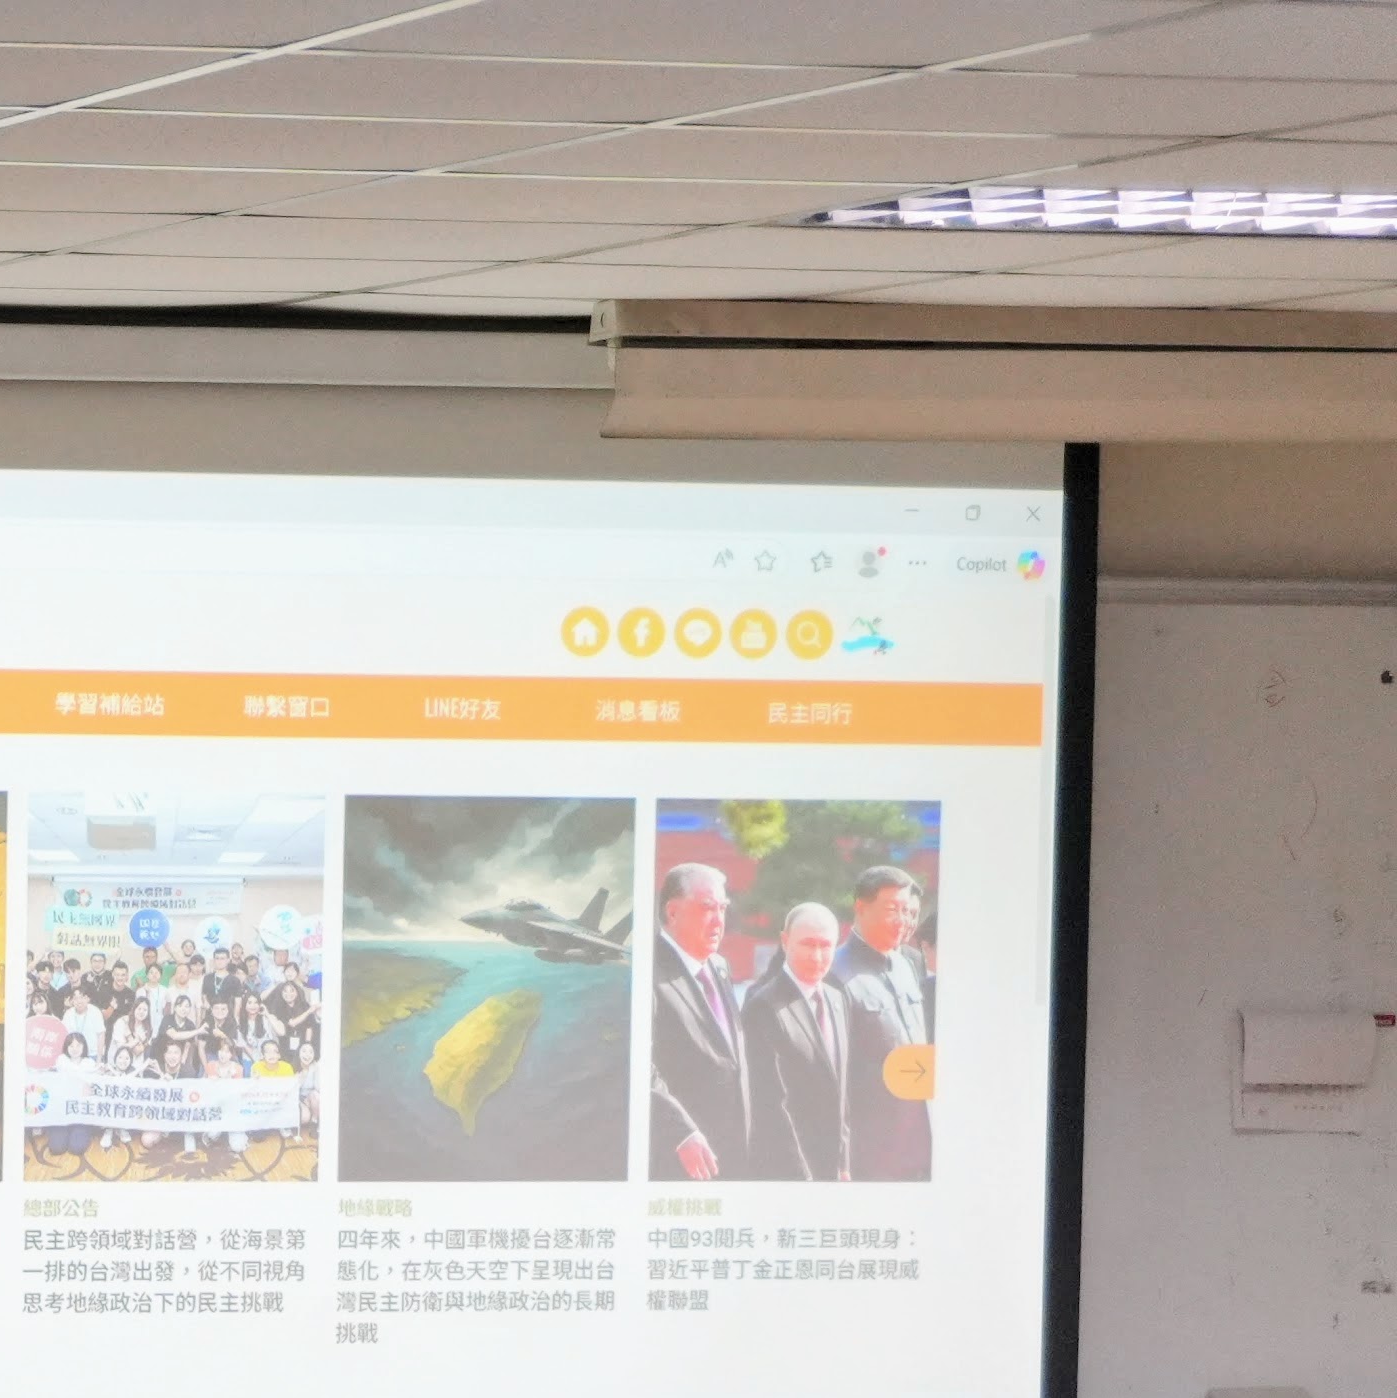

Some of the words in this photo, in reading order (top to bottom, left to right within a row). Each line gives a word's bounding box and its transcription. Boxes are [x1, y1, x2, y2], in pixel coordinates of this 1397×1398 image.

[956, 556, 1007, 575] Copilot
[55, 691, 165, 717] 學習補給站
[244, 694, 330, 718] 聯繫窗口
[424, 697, 501, 722] LINE好友
[596, 699, 681, 724] 消息看板
[768, 701, 853, 726] 民主同行
[23, 1228, 306, 1251] 民主跨領域對話營，從海景第
[338, 1228, 616, 1250] 四年來，中國軍機擾台逐漸常
[22, 1260, 305, 1283] 一排的台灣出發，從不同視角
[337, 1260, 615, 1281] 態化，在灰色天空下呈現出台
[646, 1259, 920, 1281] 習近平普丁金正恩同台展現威
[22, 1292, 284, 1314] 思考地緣政治下的民主挑戰
[336, 1291, 616, 1313] 灣民主防衛與地緣政治的長期
[646, 1290, 710, 1312] 權聯盟
[335, 1322, 378, 1344] 挑戰
